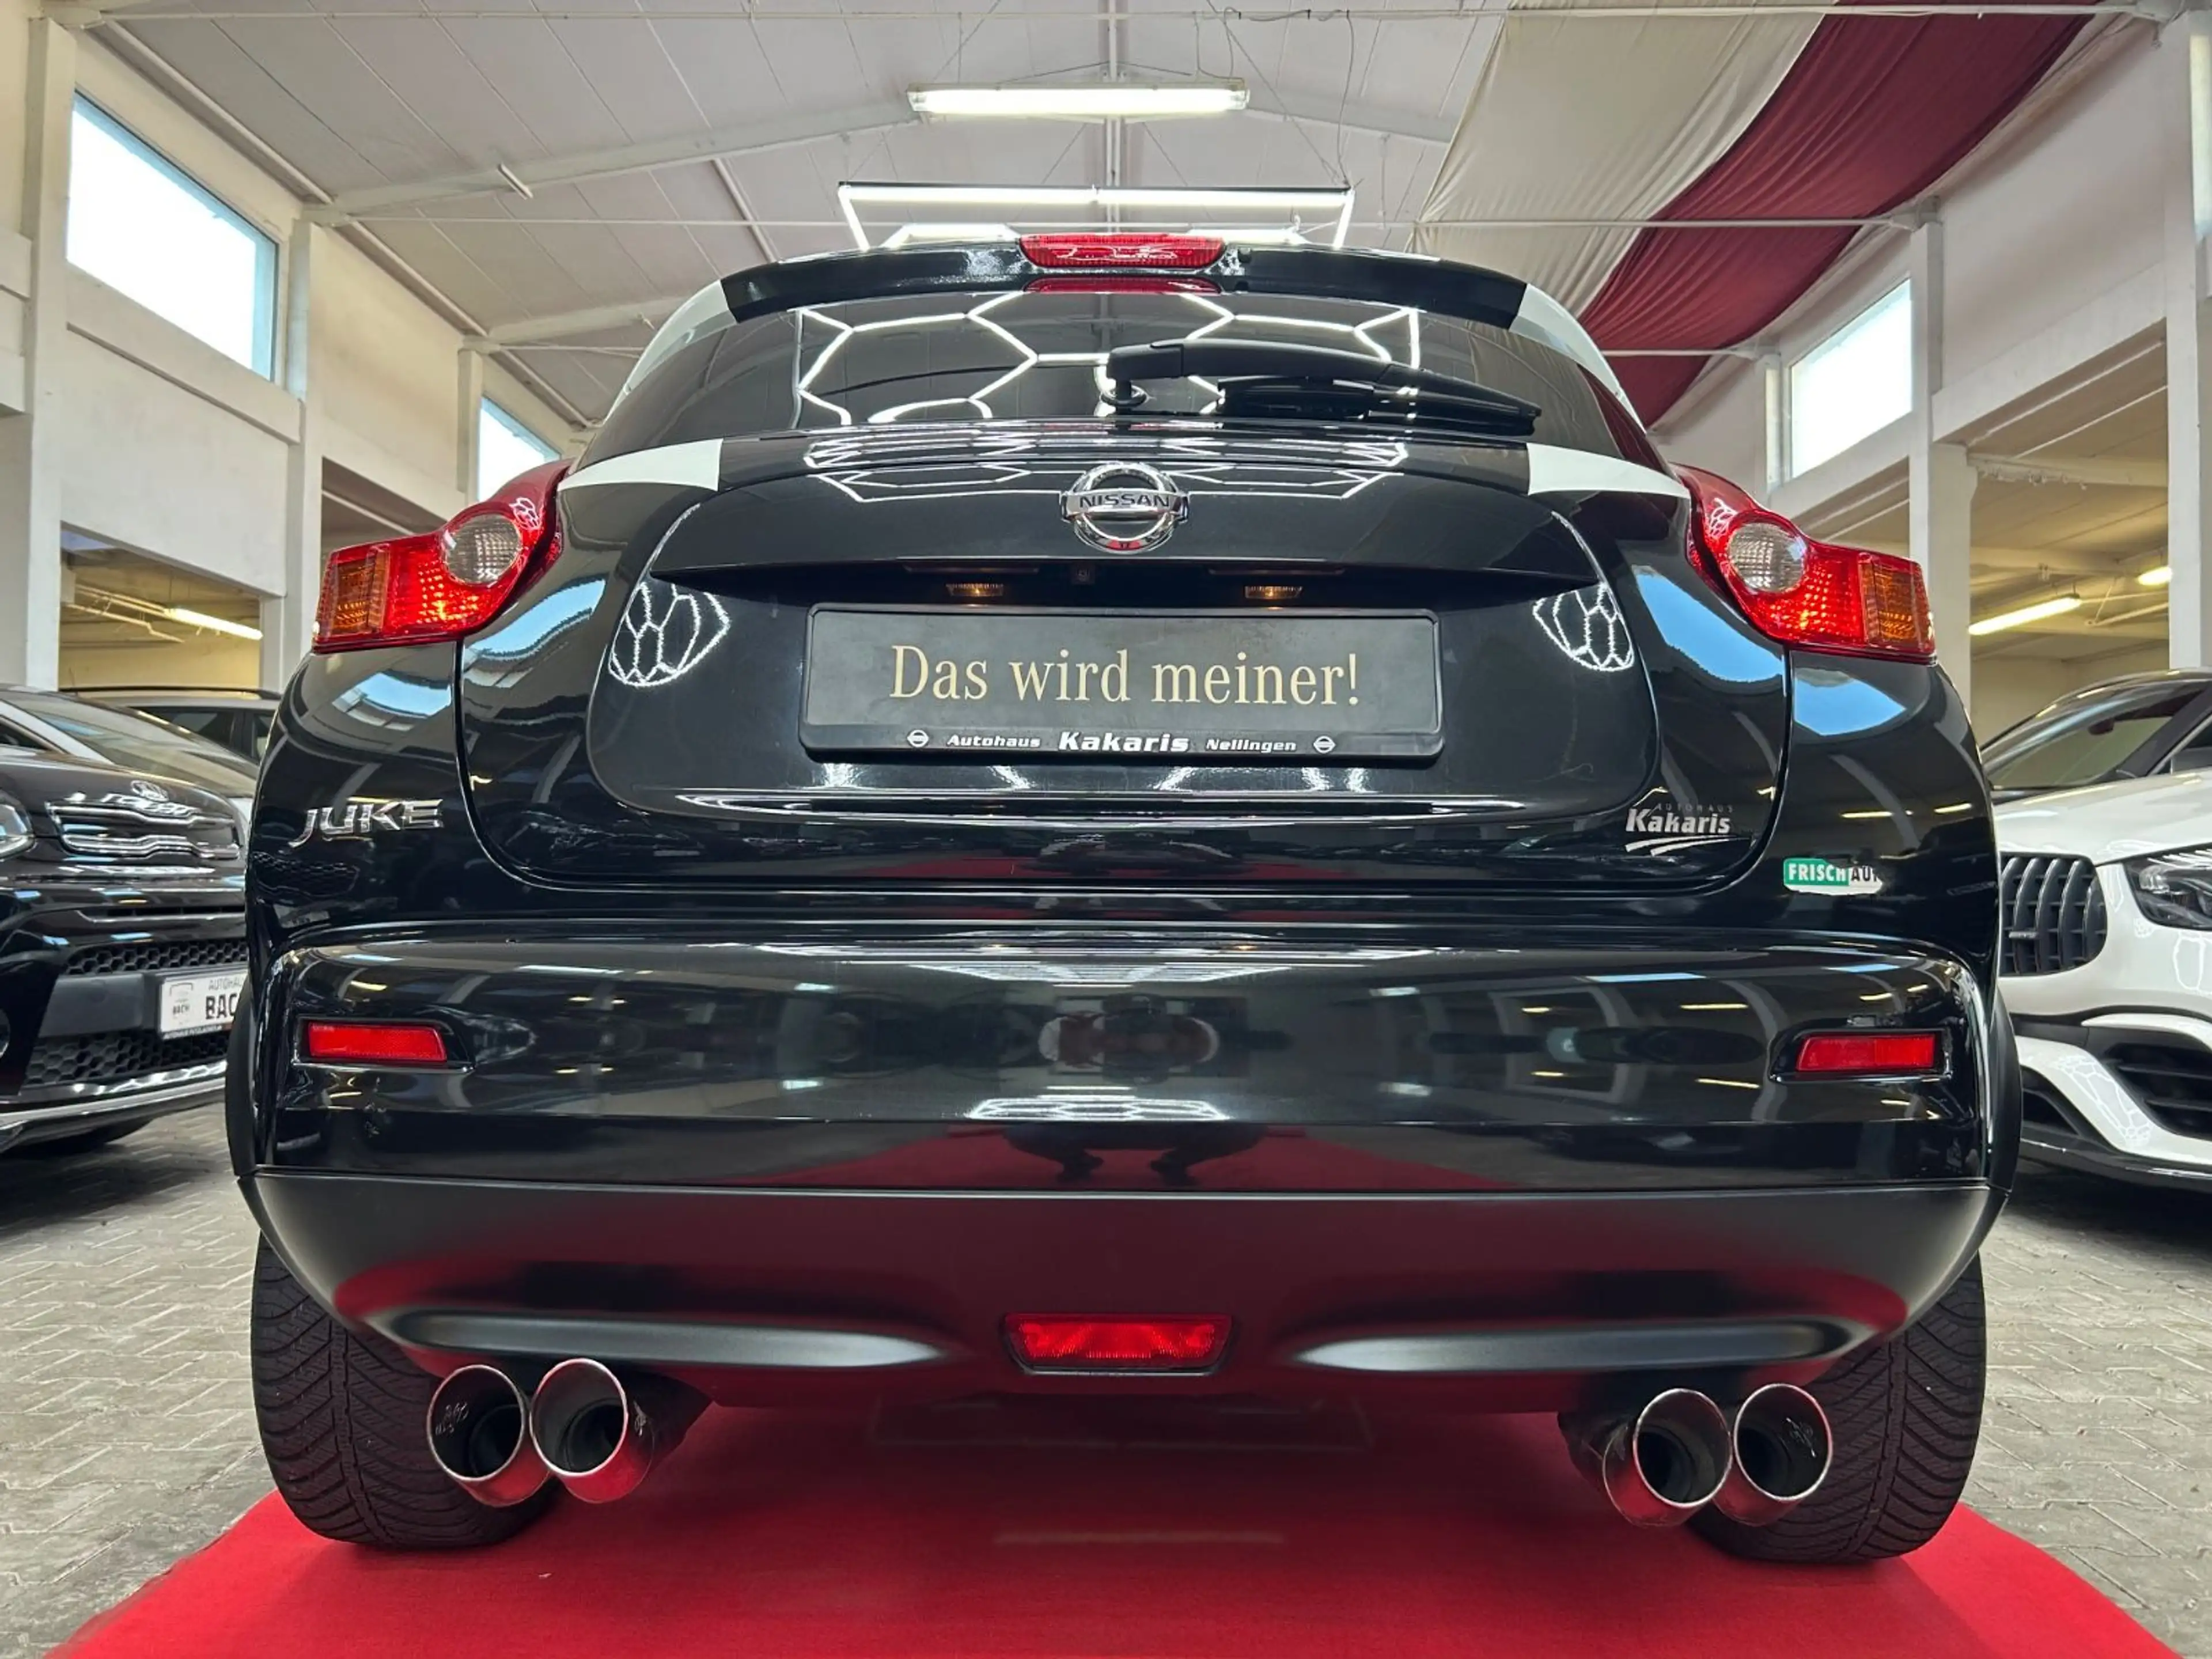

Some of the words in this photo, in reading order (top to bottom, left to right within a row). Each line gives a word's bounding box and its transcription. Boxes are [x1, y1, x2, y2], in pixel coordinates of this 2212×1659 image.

[1080, 494, 1169, 508] NISSAN
[889, 645, 988, 701] Das
[1007, 648, 1131, 703] wird
[1150, 651, 1359, 705] meiner!
[946, 734, 1041, 748] Autohaus
[1058, 731, 1190, 752] Kakaris
[1206, 738, 1297, 753] Nellingen
[287, 798, 444, 848] JUKE
[1625, 808, 1731, 834] Kakaris
